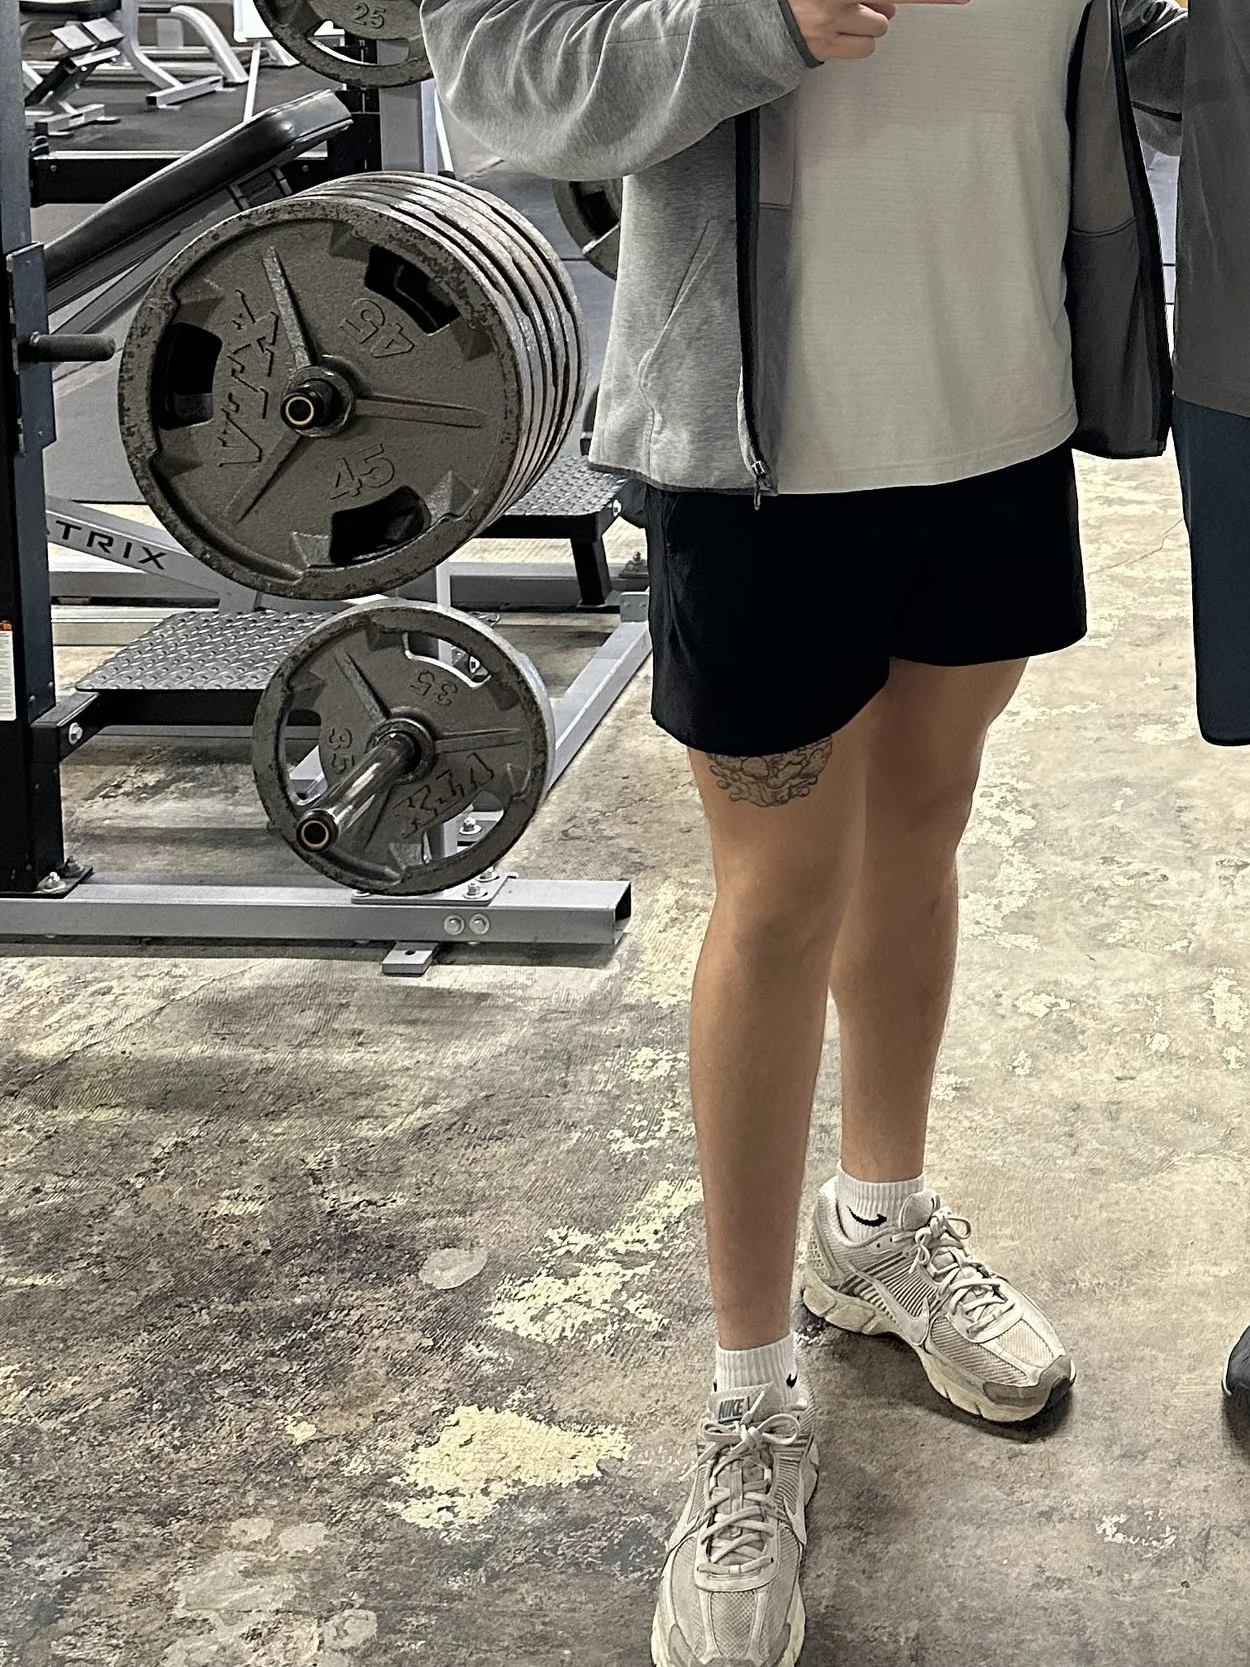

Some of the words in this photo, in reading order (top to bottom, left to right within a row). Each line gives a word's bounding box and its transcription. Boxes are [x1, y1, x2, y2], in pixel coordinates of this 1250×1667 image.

[353, 2, 387, 29] 25
[338, 297, 416, 360] 45
[328, 442, 396, 501] 45
[54, 519, 168, 571] TRIX
[408, 670, 459, 707] 35
[718, 1397, 745, 1421] NIKE
